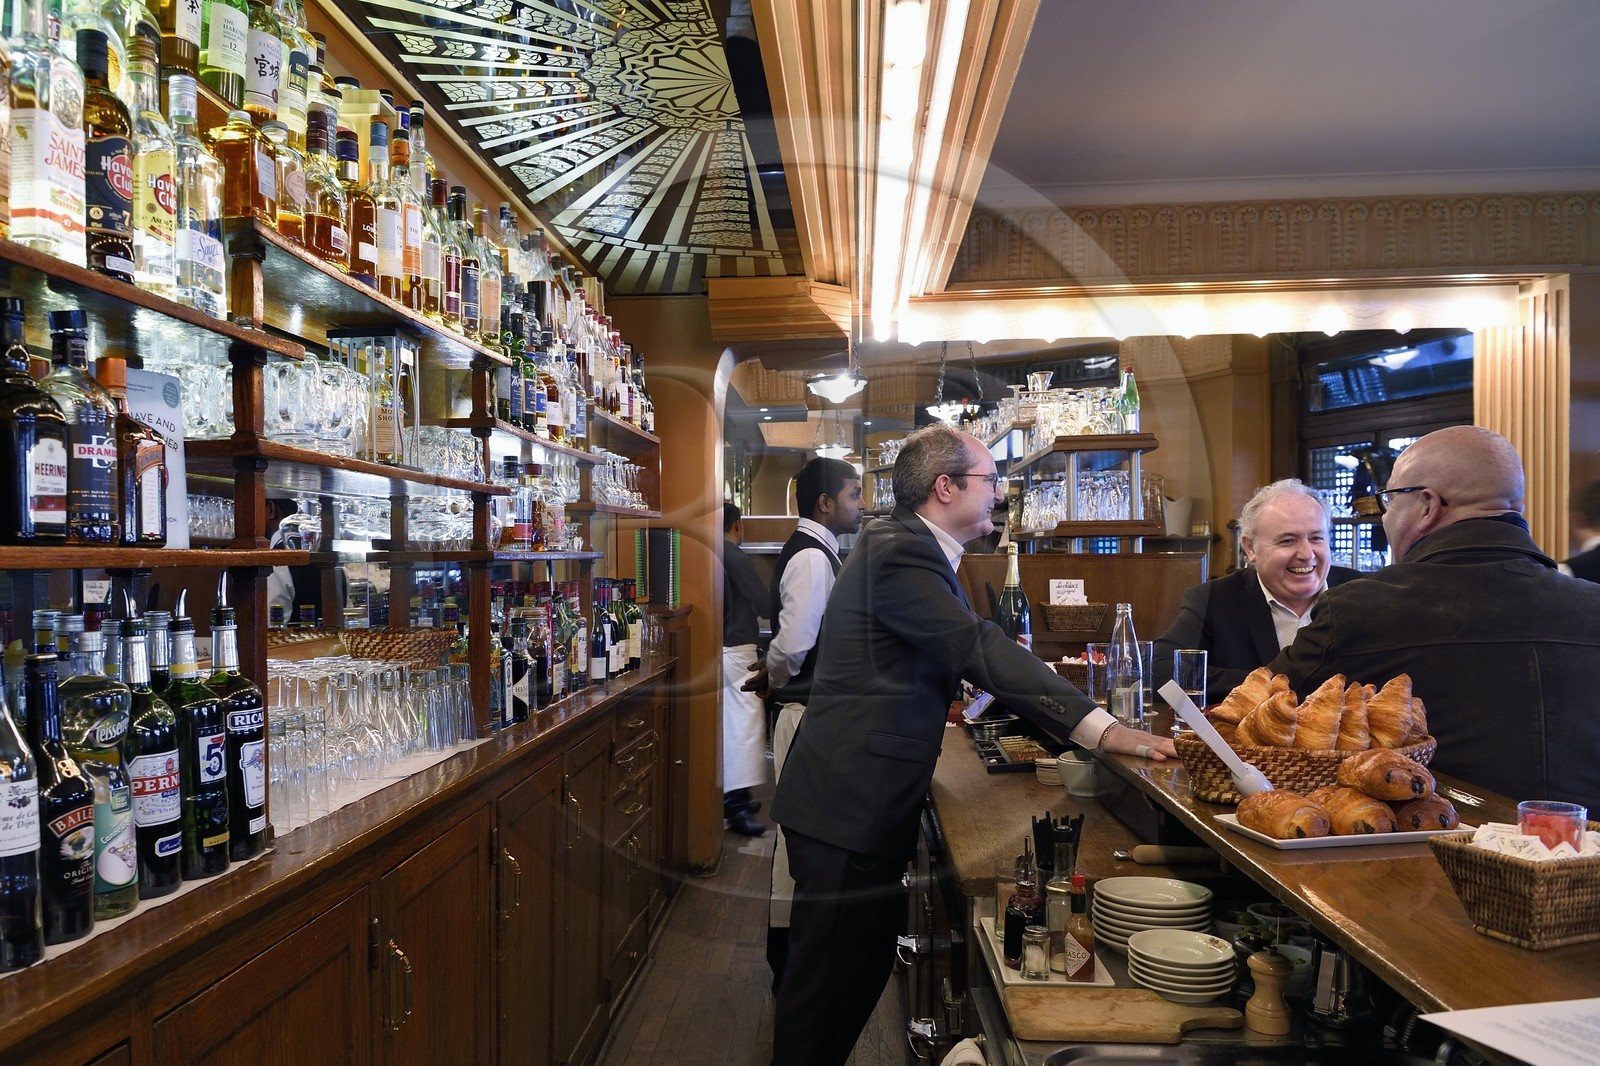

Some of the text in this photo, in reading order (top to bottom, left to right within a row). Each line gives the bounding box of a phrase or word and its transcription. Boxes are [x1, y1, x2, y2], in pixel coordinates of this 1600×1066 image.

[229, 42, 237, 51] 12
[50, 131, 85, 165] SAINT
[44, 151, 85, 181] JAMES
[122, 210, 130, 226] 7
[156, 417, 177, 433] AND
[34, 462, 66, 478] HEERING
[94, 714, 129, 743] Teisseire
